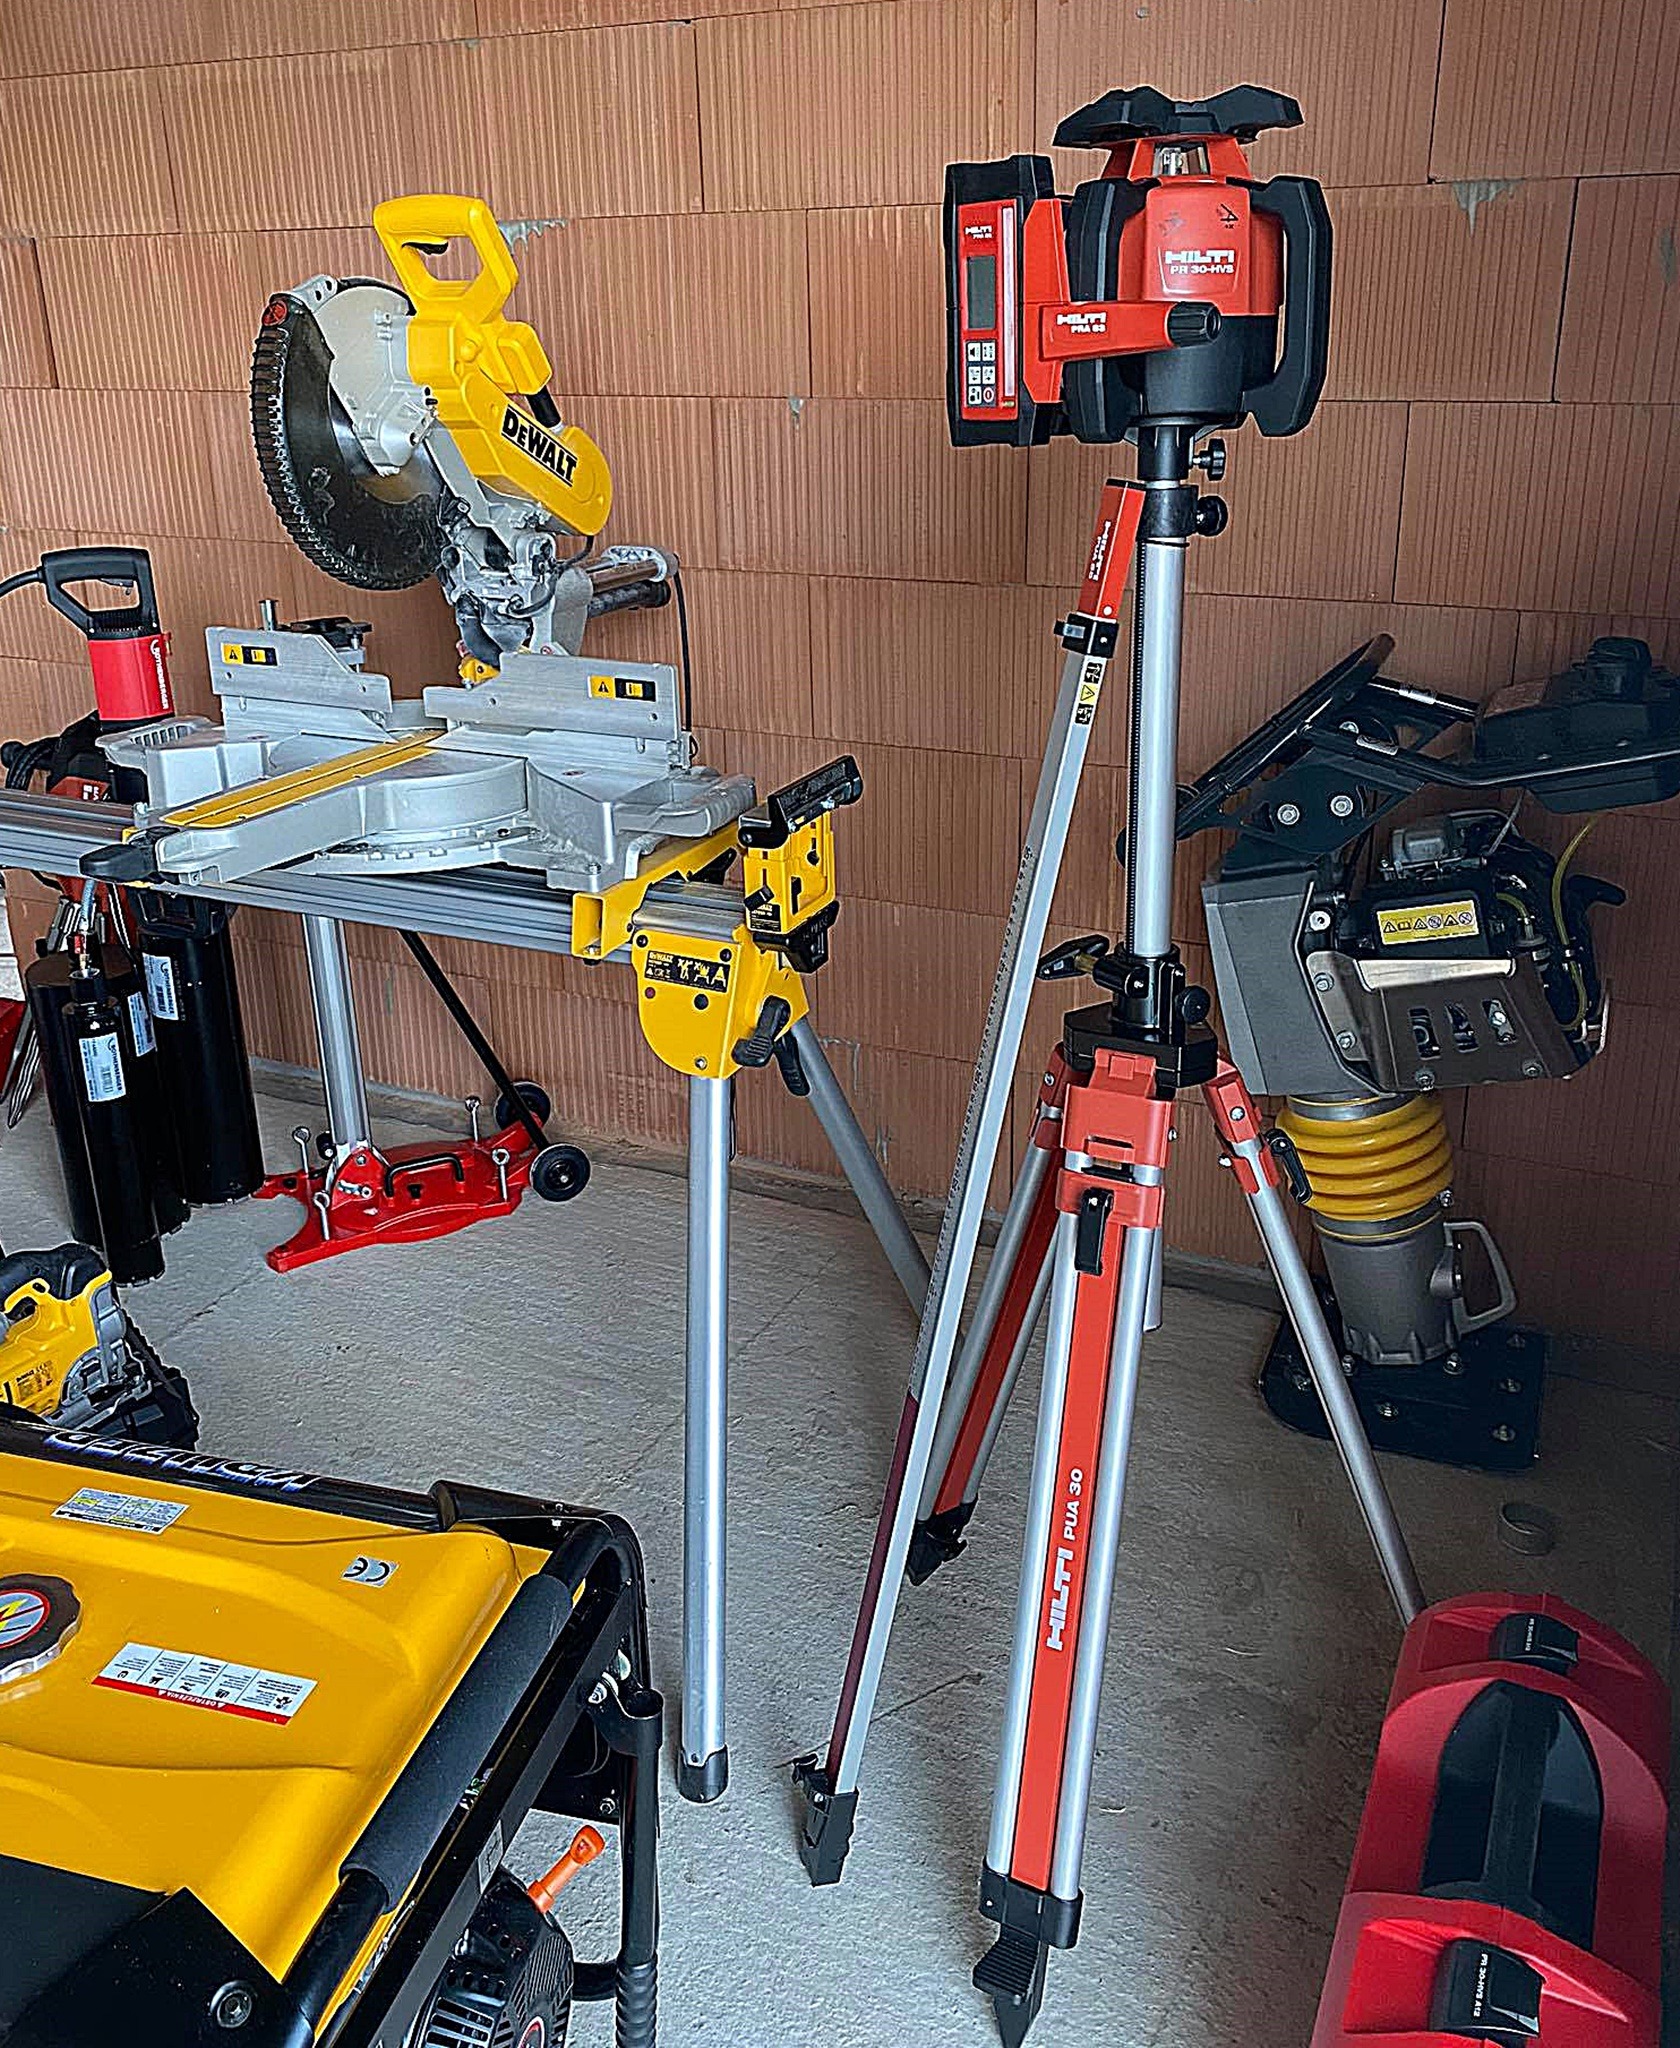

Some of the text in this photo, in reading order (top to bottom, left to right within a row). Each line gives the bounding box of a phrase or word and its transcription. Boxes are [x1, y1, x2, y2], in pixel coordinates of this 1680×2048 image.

[1165, 250, 1235, 264] HILTI
[1170, 265, 1188, 275] PR
[1057, 312, 1107, 325] HILTI
[502, 406, 578, 482] DEWALT
[1093, 520, 1112, 581] HILTI
[1046, 1468, 1084, 1651] HILTI PUA 30
[1480, 1953, 1489, 1966] PR
